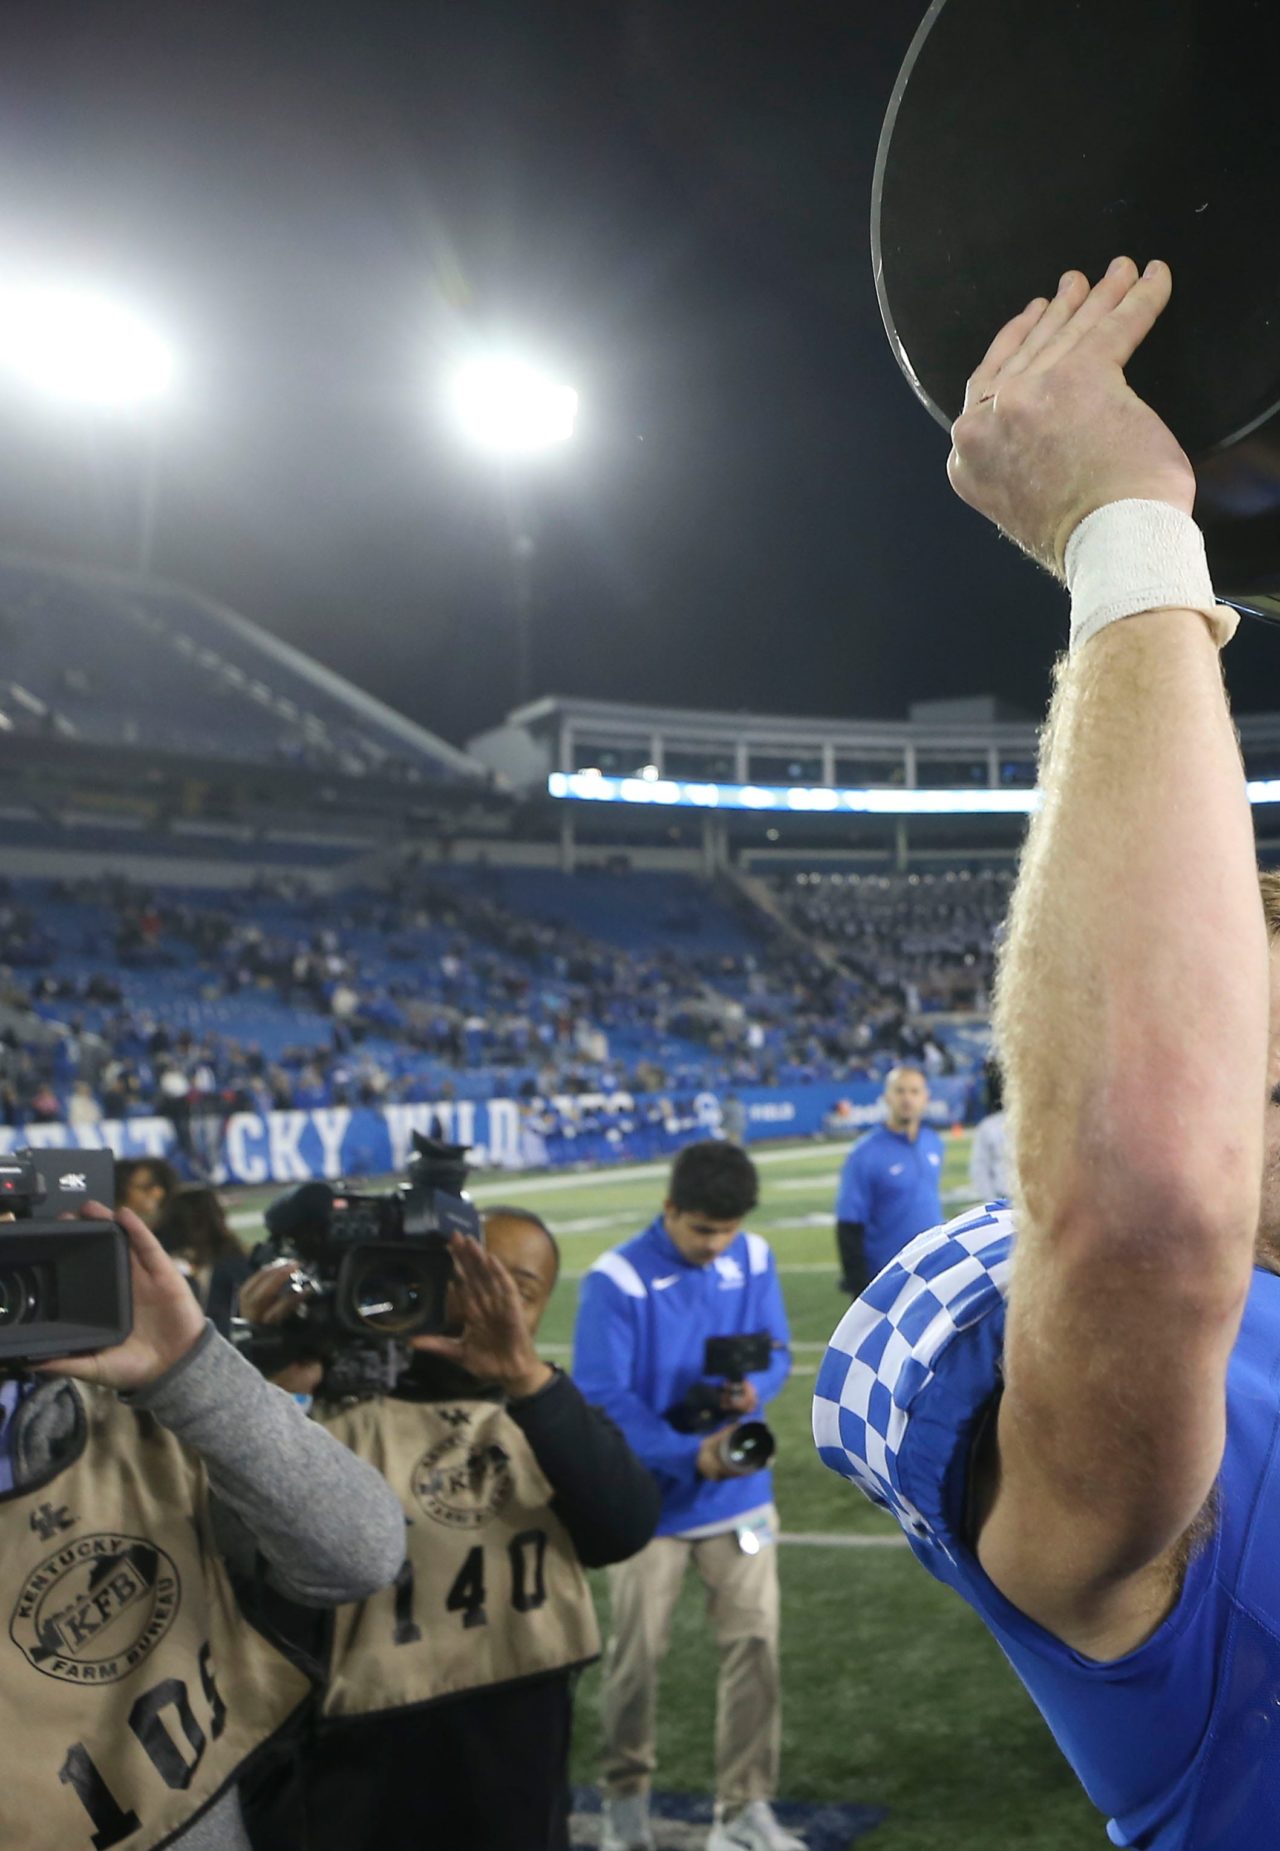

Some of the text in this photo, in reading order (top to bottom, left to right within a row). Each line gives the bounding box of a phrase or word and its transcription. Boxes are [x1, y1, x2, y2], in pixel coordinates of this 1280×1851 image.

[59, 1173, 87, 1188] 4K
[19, 1539, 122, 1619] KENTUCKY
[64, 1571, 138, 1645] KFB
[394, 1529, 548, 1645] 140
[51, 1576, 175, 1681] FARM BUREAU
